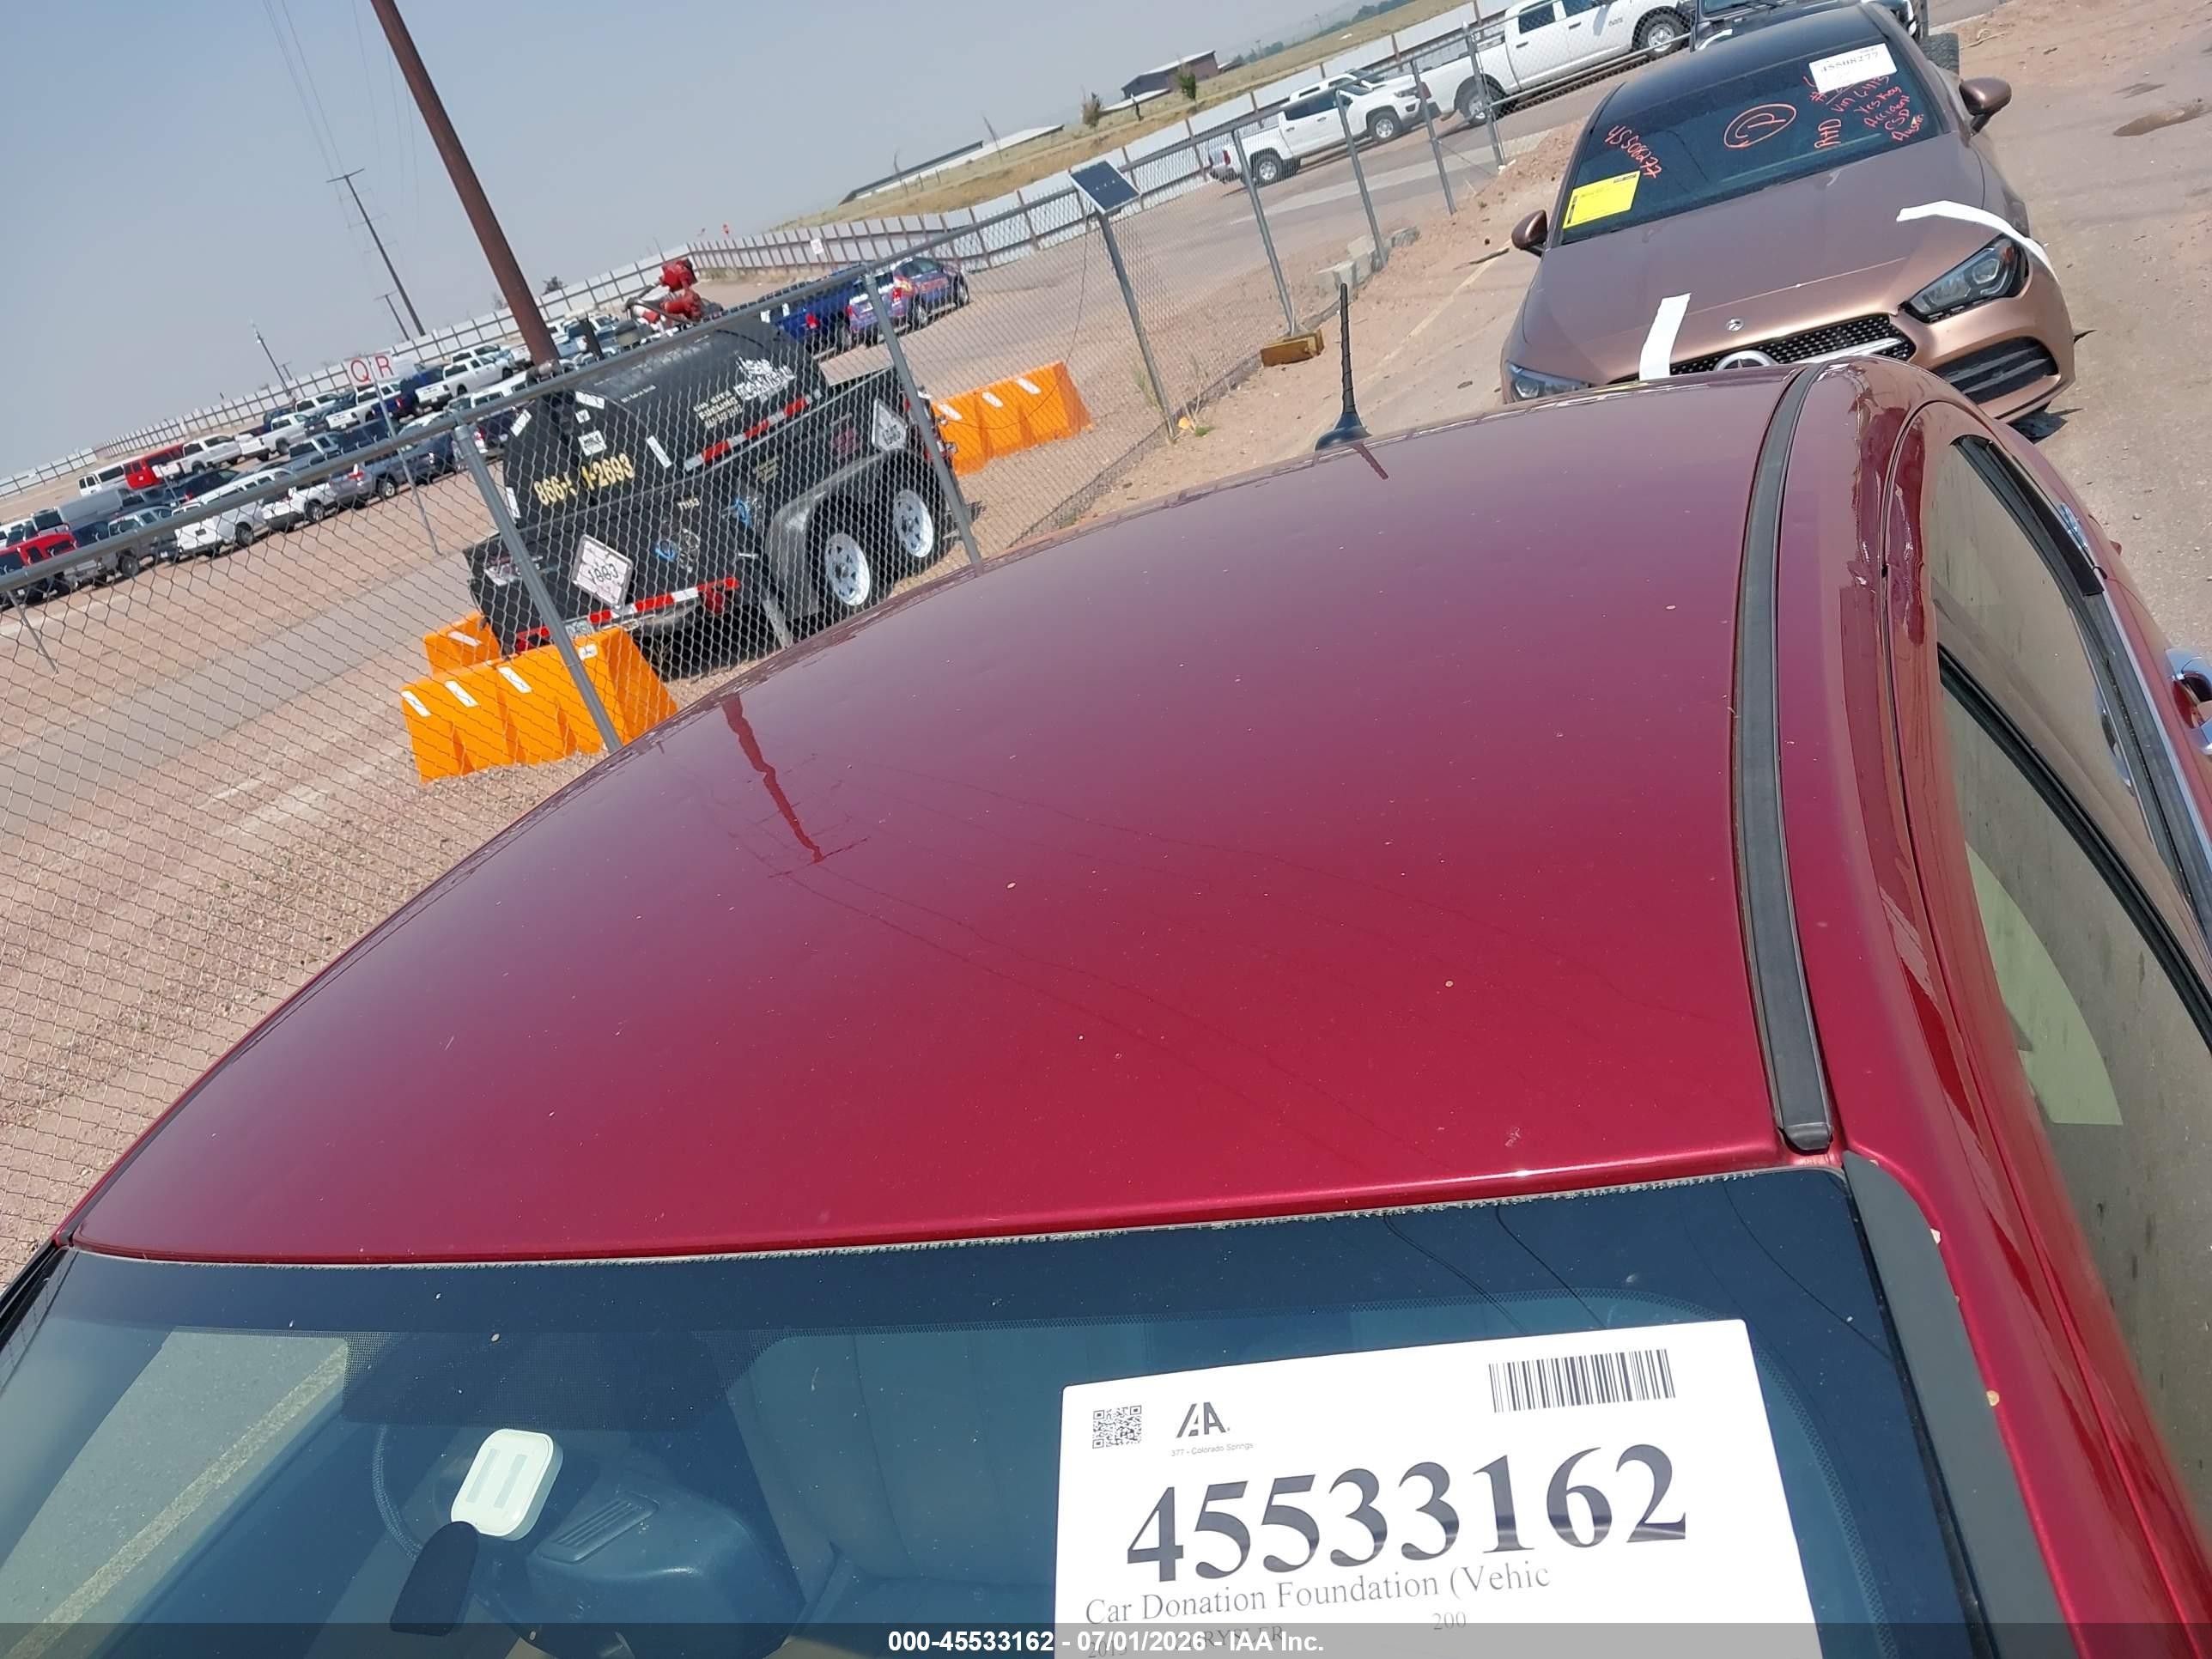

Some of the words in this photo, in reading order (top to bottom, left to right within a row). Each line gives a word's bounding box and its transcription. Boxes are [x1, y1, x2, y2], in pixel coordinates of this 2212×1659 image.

[350, 359, 371, 382] Q
[375, 356, 394, 378] R
[1191, 1444, 1224, 1455] Colorado
[1226, 1443, 1254, 1452] Springs
[1126, 1443, 1687, 1583] 45533162
[1085, 1599, 1132, 1624] Car
[1143, 1589, 1267, 1620] Donation
[1277, 1572, 1438, 1607] Foundation
[1449, 1560, 1551, 1601] (Vehic
[1432, 1610, 1467, 1631] 200
